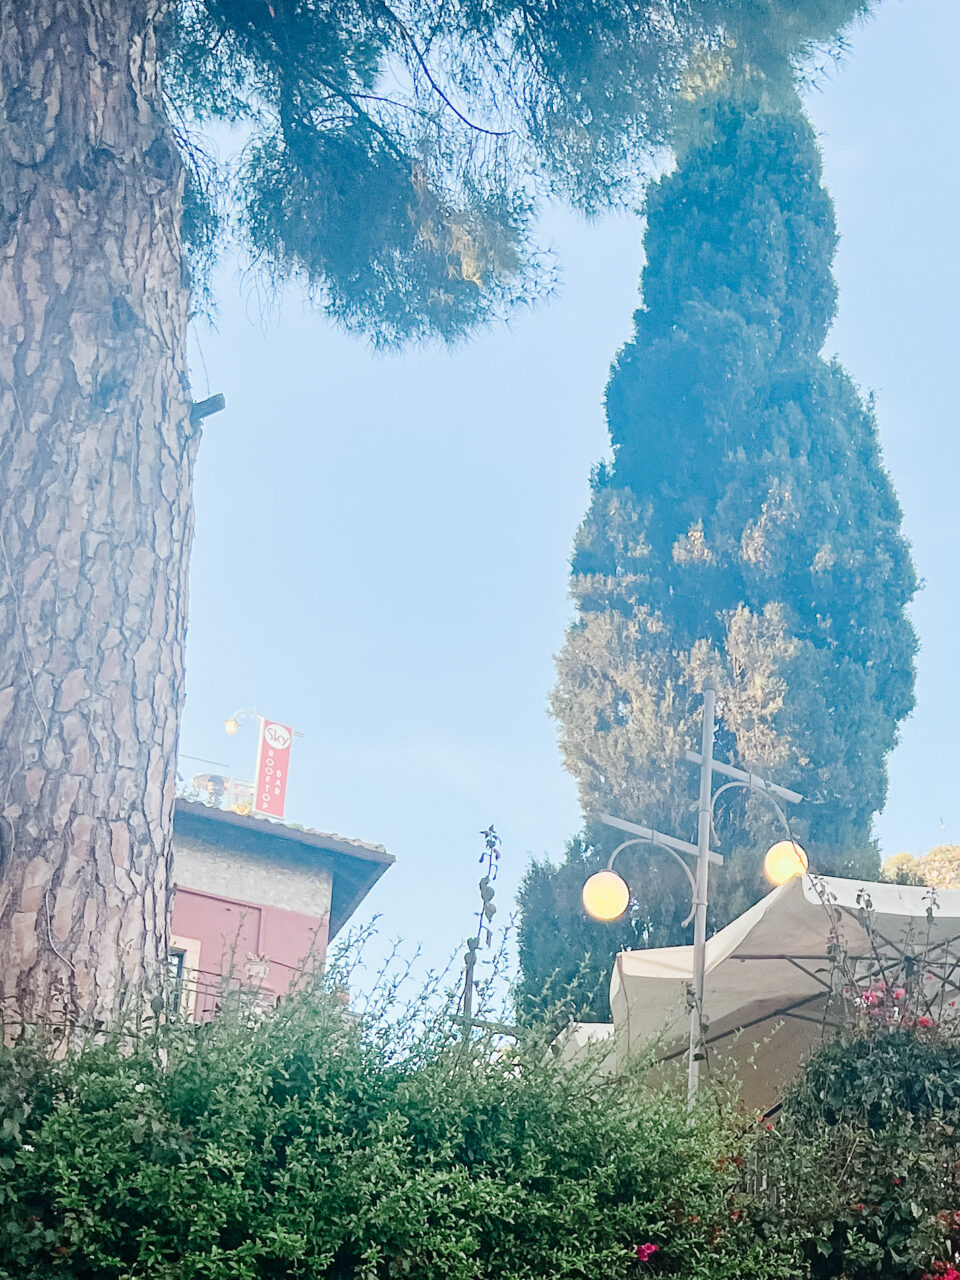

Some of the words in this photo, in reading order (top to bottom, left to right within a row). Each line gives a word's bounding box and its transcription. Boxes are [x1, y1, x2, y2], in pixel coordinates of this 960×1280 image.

[266, 727, 289, 747] Sky
[262, 749, 274, 809] ROOFTOP
[274, 769, 282, 796] BAR
